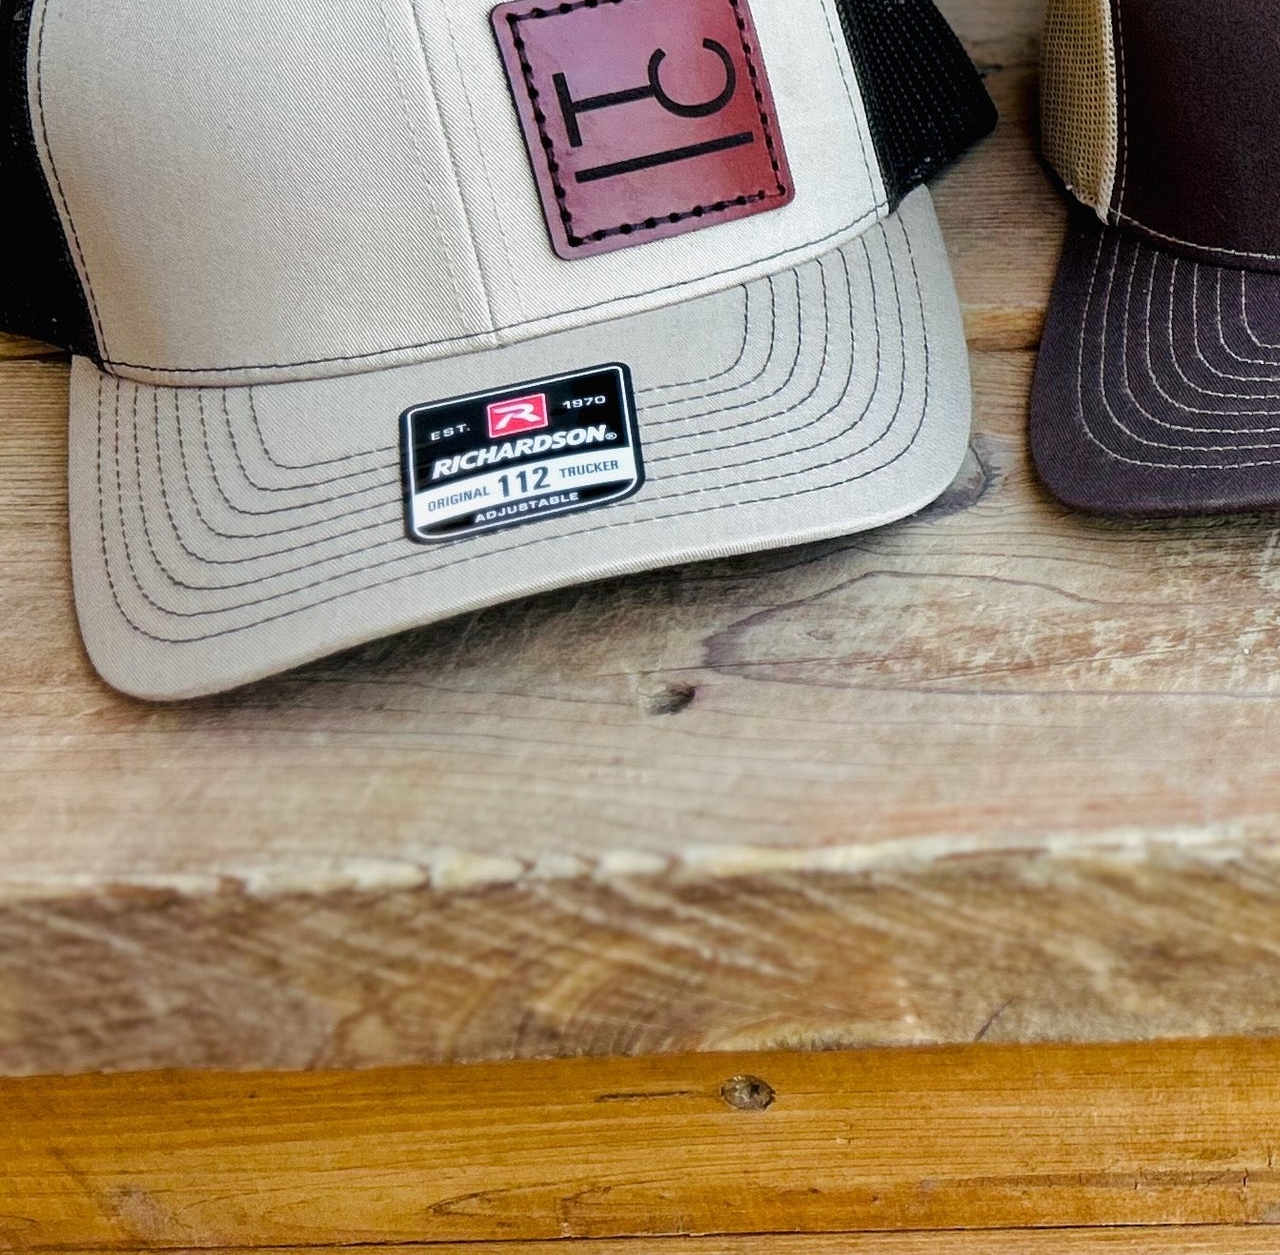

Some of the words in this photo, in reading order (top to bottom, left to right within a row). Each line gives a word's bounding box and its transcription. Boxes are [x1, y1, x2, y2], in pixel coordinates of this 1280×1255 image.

[430, 424, 471, 441] EST.
[562, 395, 606, 410] 1970
[427, 486, 490, 512] ORIGINAL
[497, 466, 551, 498] 112
[559, 460, 619, 478] TRUCKER
[474, 492, 579, 523] ADJUSTABLE
